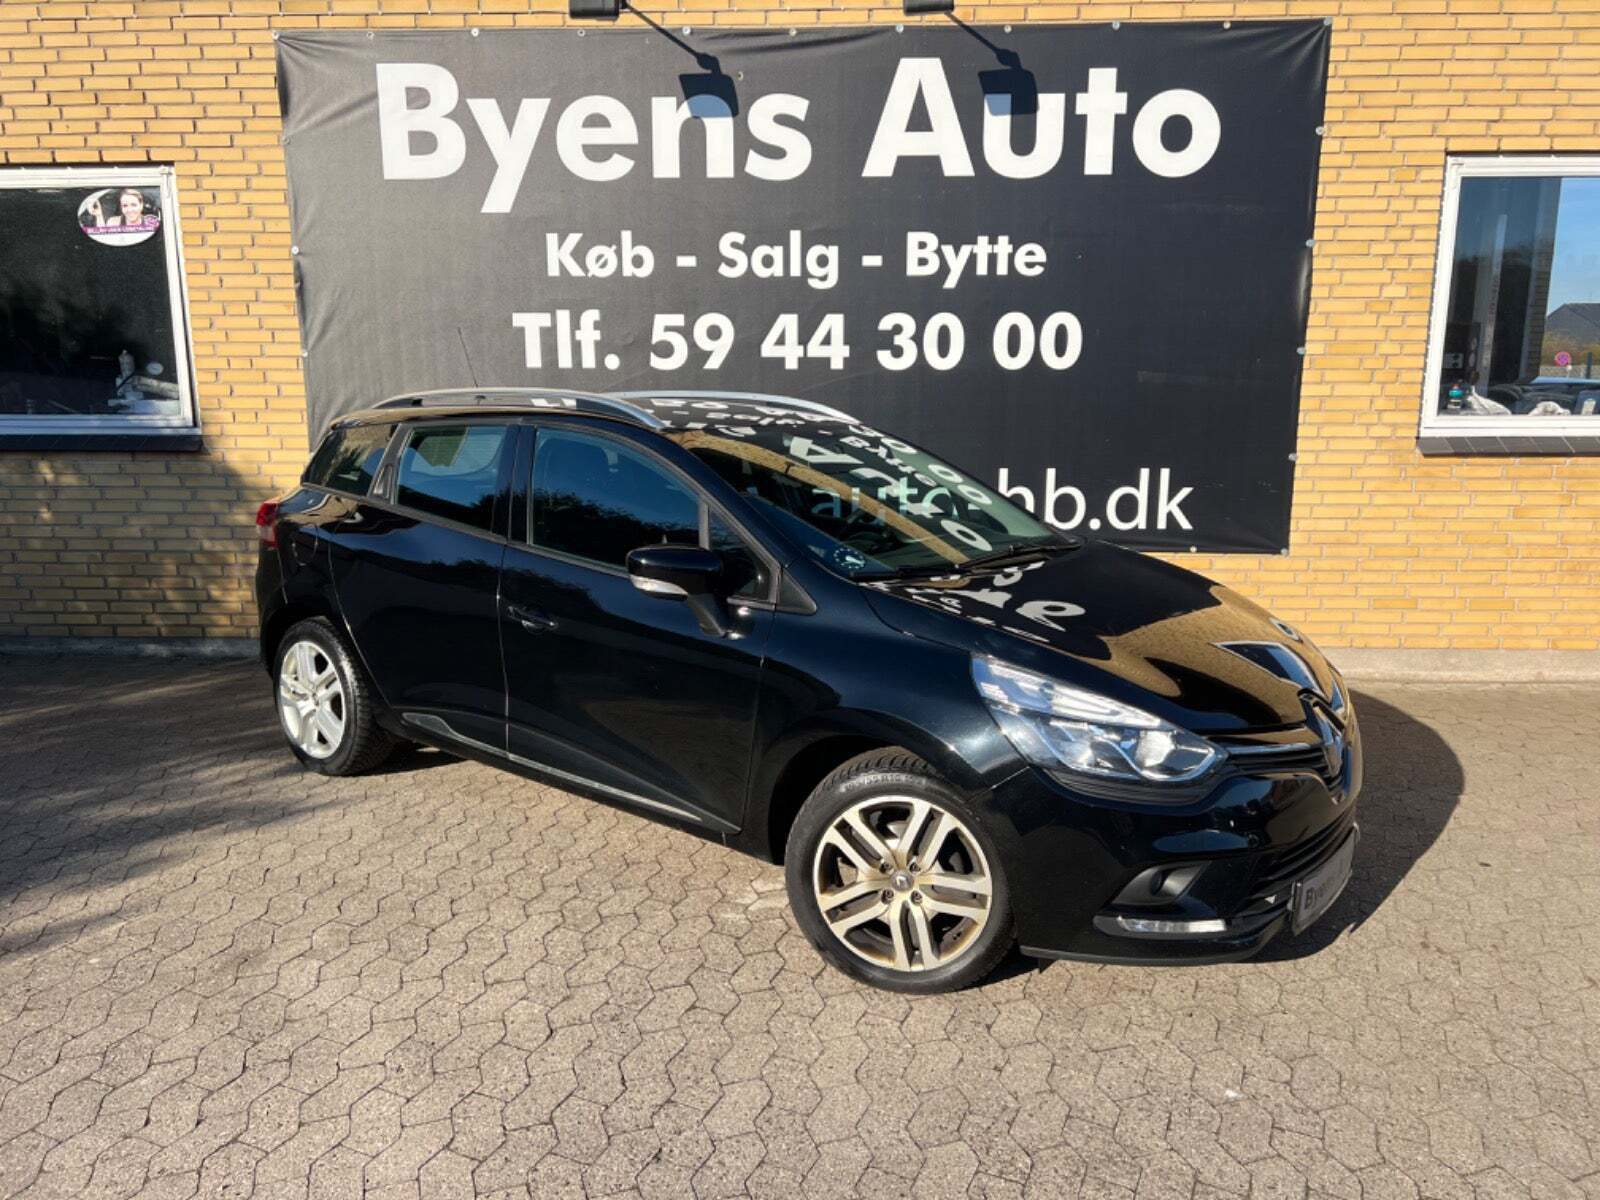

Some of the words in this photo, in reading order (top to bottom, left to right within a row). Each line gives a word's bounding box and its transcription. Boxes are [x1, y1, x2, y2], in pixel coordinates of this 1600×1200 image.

[376, 62, 812, 215] Byens
[862, 57, 1221, 179] Auto
[546, 230, 655, 279] Køb
[718, 230, 840, 290] Salg
[906, 231, 1048, 289] Bytte
[511, 308, 622, 371] Tlf.
[649, 312, 735, 371] 59
[760, 313, 850, 370] 44
[876, 312, 965, 371] 30
[992, 311, 1083, 371] 00
